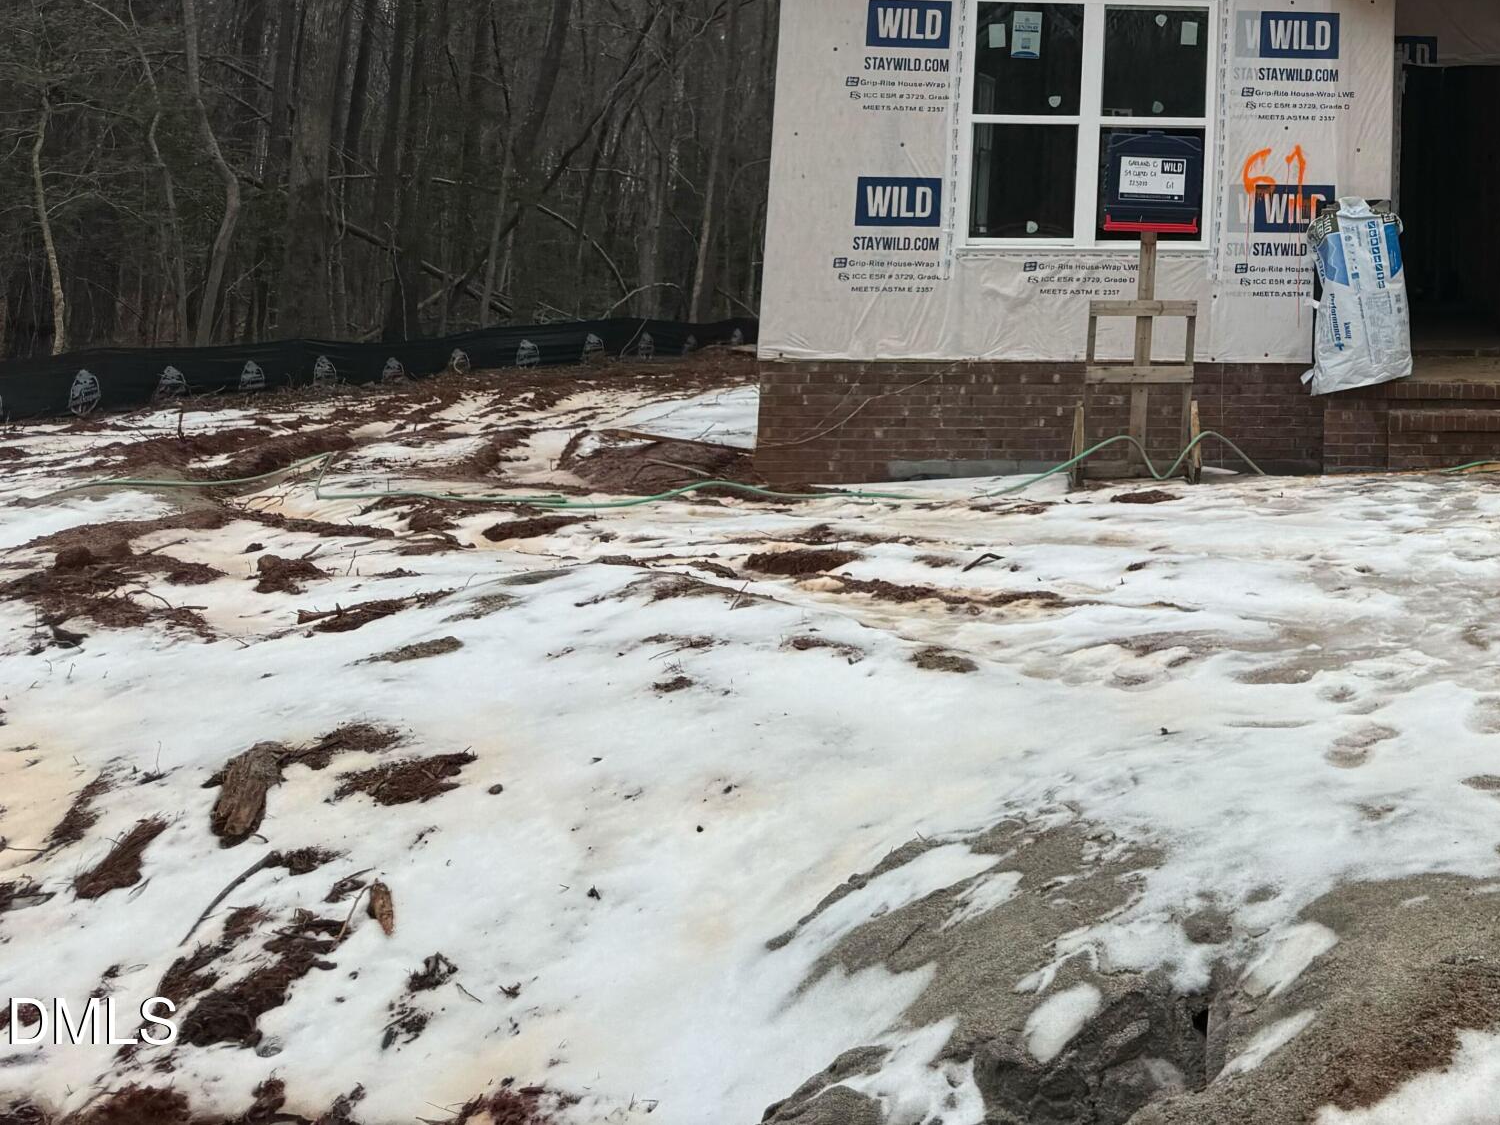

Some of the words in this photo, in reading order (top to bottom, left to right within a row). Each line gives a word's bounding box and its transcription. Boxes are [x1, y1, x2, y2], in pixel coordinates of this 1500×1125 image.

[877, 7, 942, 40] WILD
[1269, 19, 1332, 51] WILD
[865, 56, 949, 71] STAYWILD.COM
[1259, 67, 1338, 81] STAYWILD.COM
[1163, 162, 1183, 172] WILD
[866, 185, 932, 218] WILD
[853, 237, 939, 250] STAYWILD.COM
